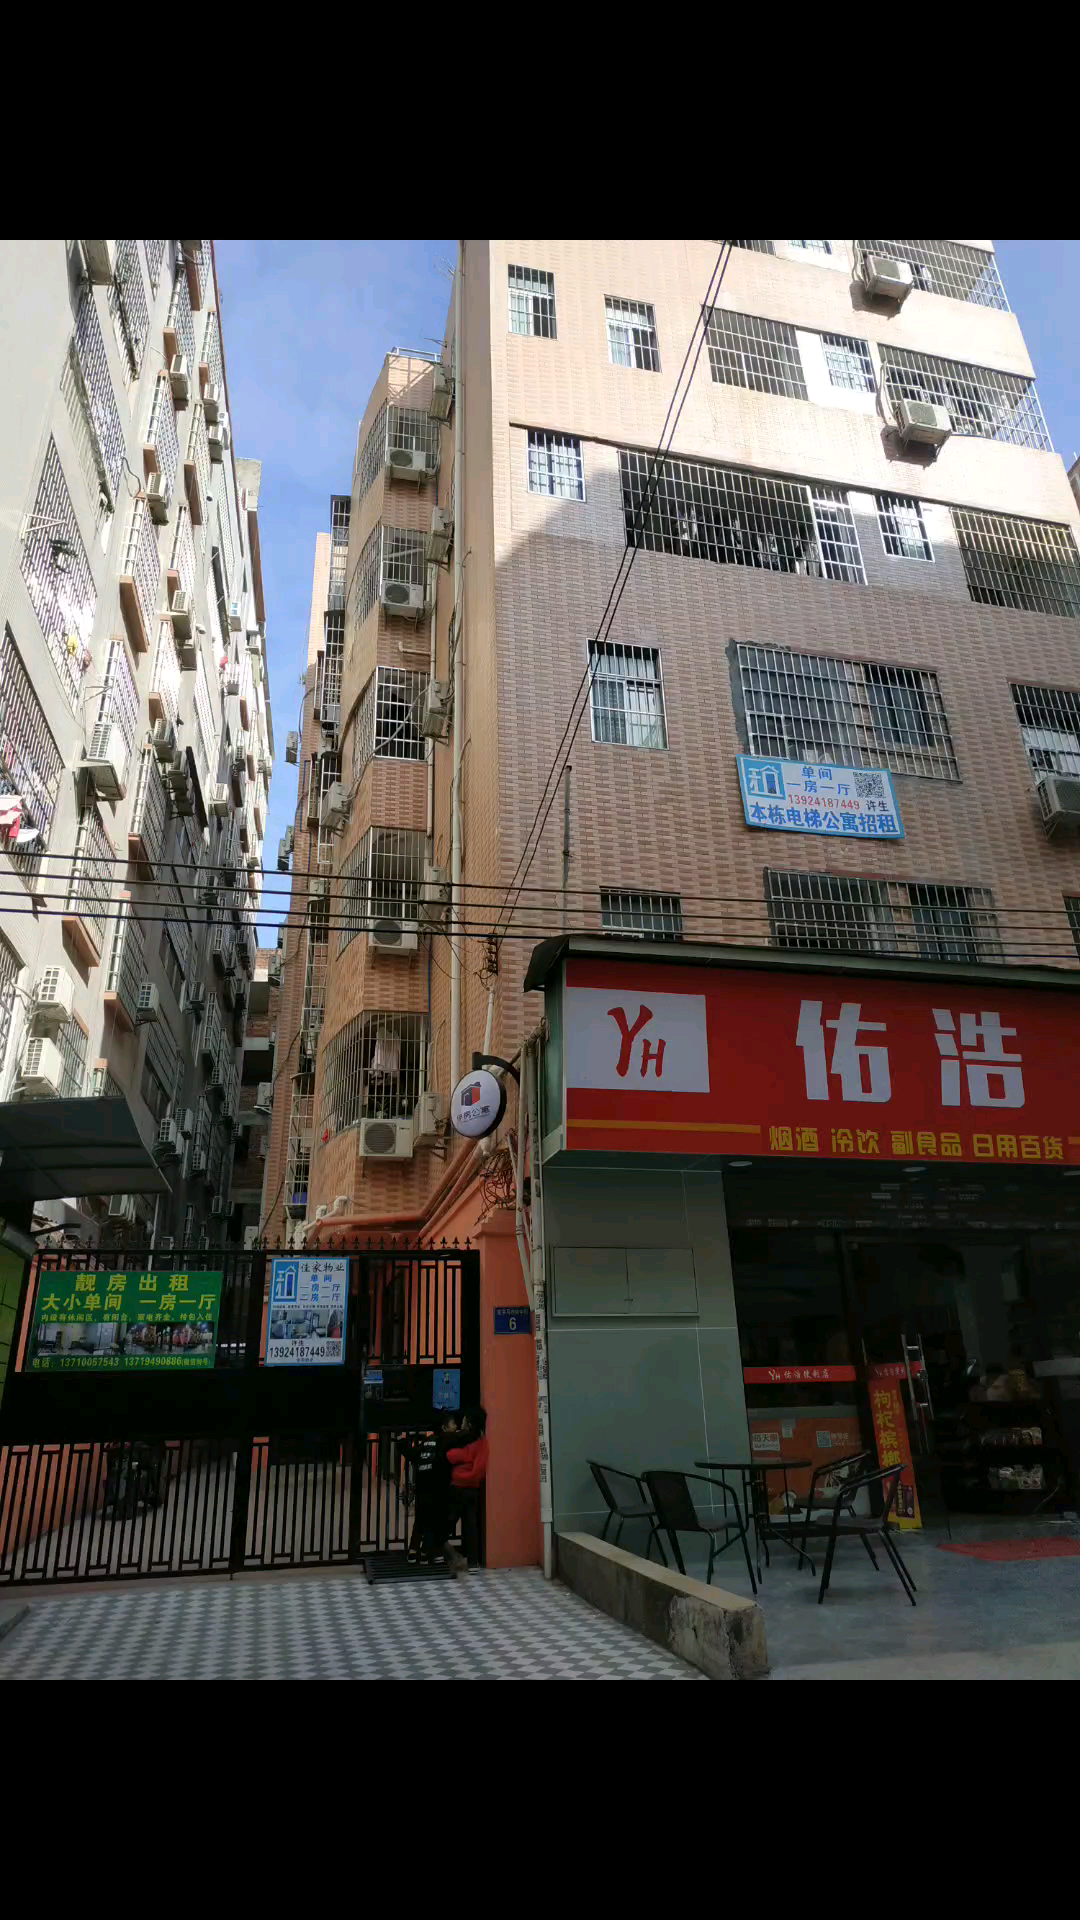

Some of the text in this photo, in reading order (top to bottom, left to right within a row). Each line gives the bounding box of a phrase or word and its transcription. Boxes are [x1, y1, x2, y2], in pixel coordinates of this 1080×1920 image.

[801, 765, 833, 781] 单间
[786, 780, 851, 796] 一房一厅
[788, 794, 890, 812] 13924187449 许生
[750, 801, 898, 834] 本栋电梯公寓招租
[607, 1004, 667, 1078] YH
[795, 999, 1026, 1108] 佑浩
[768, 1125, 1065, 1161] 烟酒 冷饮 副食品 日用百货
[75, 1273, 190, 1293] 靓房出租
[311, 1274, 333, 1283] 单间
[300, 1283, 341, 1293] 一房一厅
[41, 1293, 217, 1312] 大小单间 一房一厅
[300, 1293, 341, 1302] 二房一厅
[508, 1316, 517, 1331] 6
[269, 1347, 325, 1359] 13924187449
